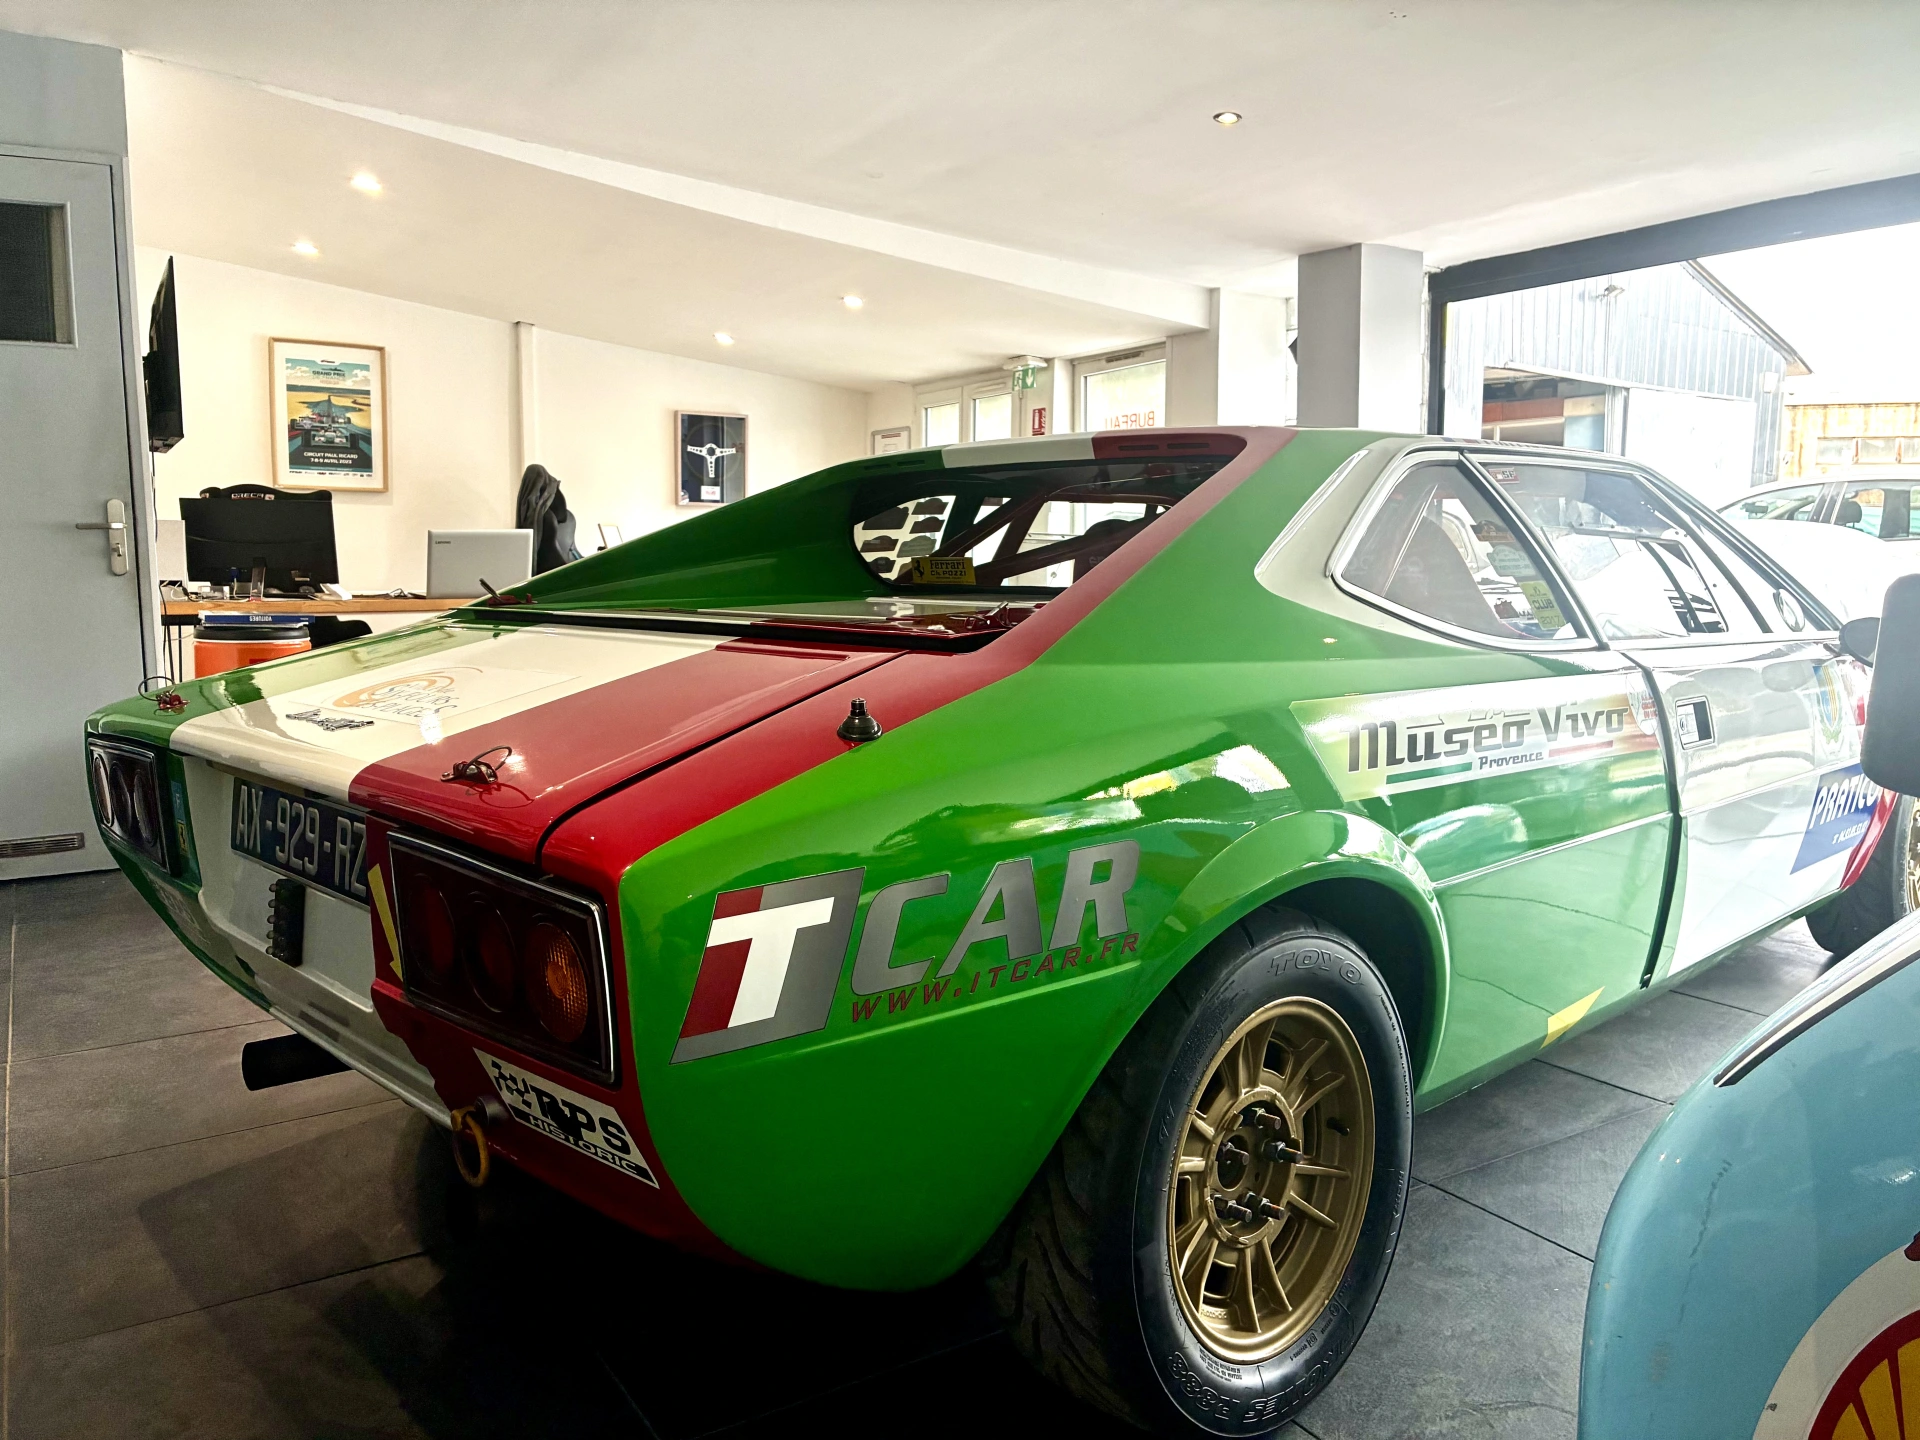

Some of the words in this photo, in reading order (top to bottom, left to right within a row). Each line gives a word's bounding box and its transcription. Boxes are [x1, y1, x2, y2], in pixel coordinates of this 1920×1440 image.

[930, 559, 966, 570] Ferrari
[1532, 599, 1555, 610] CLUB
[1540, 615, 1560, 625] 2017
[1340, 718, 1532, 773] Museo
[1537, 701, 1629, 743] Vivo
[1478, 752, 1544, 770] Provence
[851, 932, 1140, 1023] WWW.ITCAR.FR
[1270, 947, 1362, 985] TOYO
[530, 1115, 638, 1174] HISTORIC
